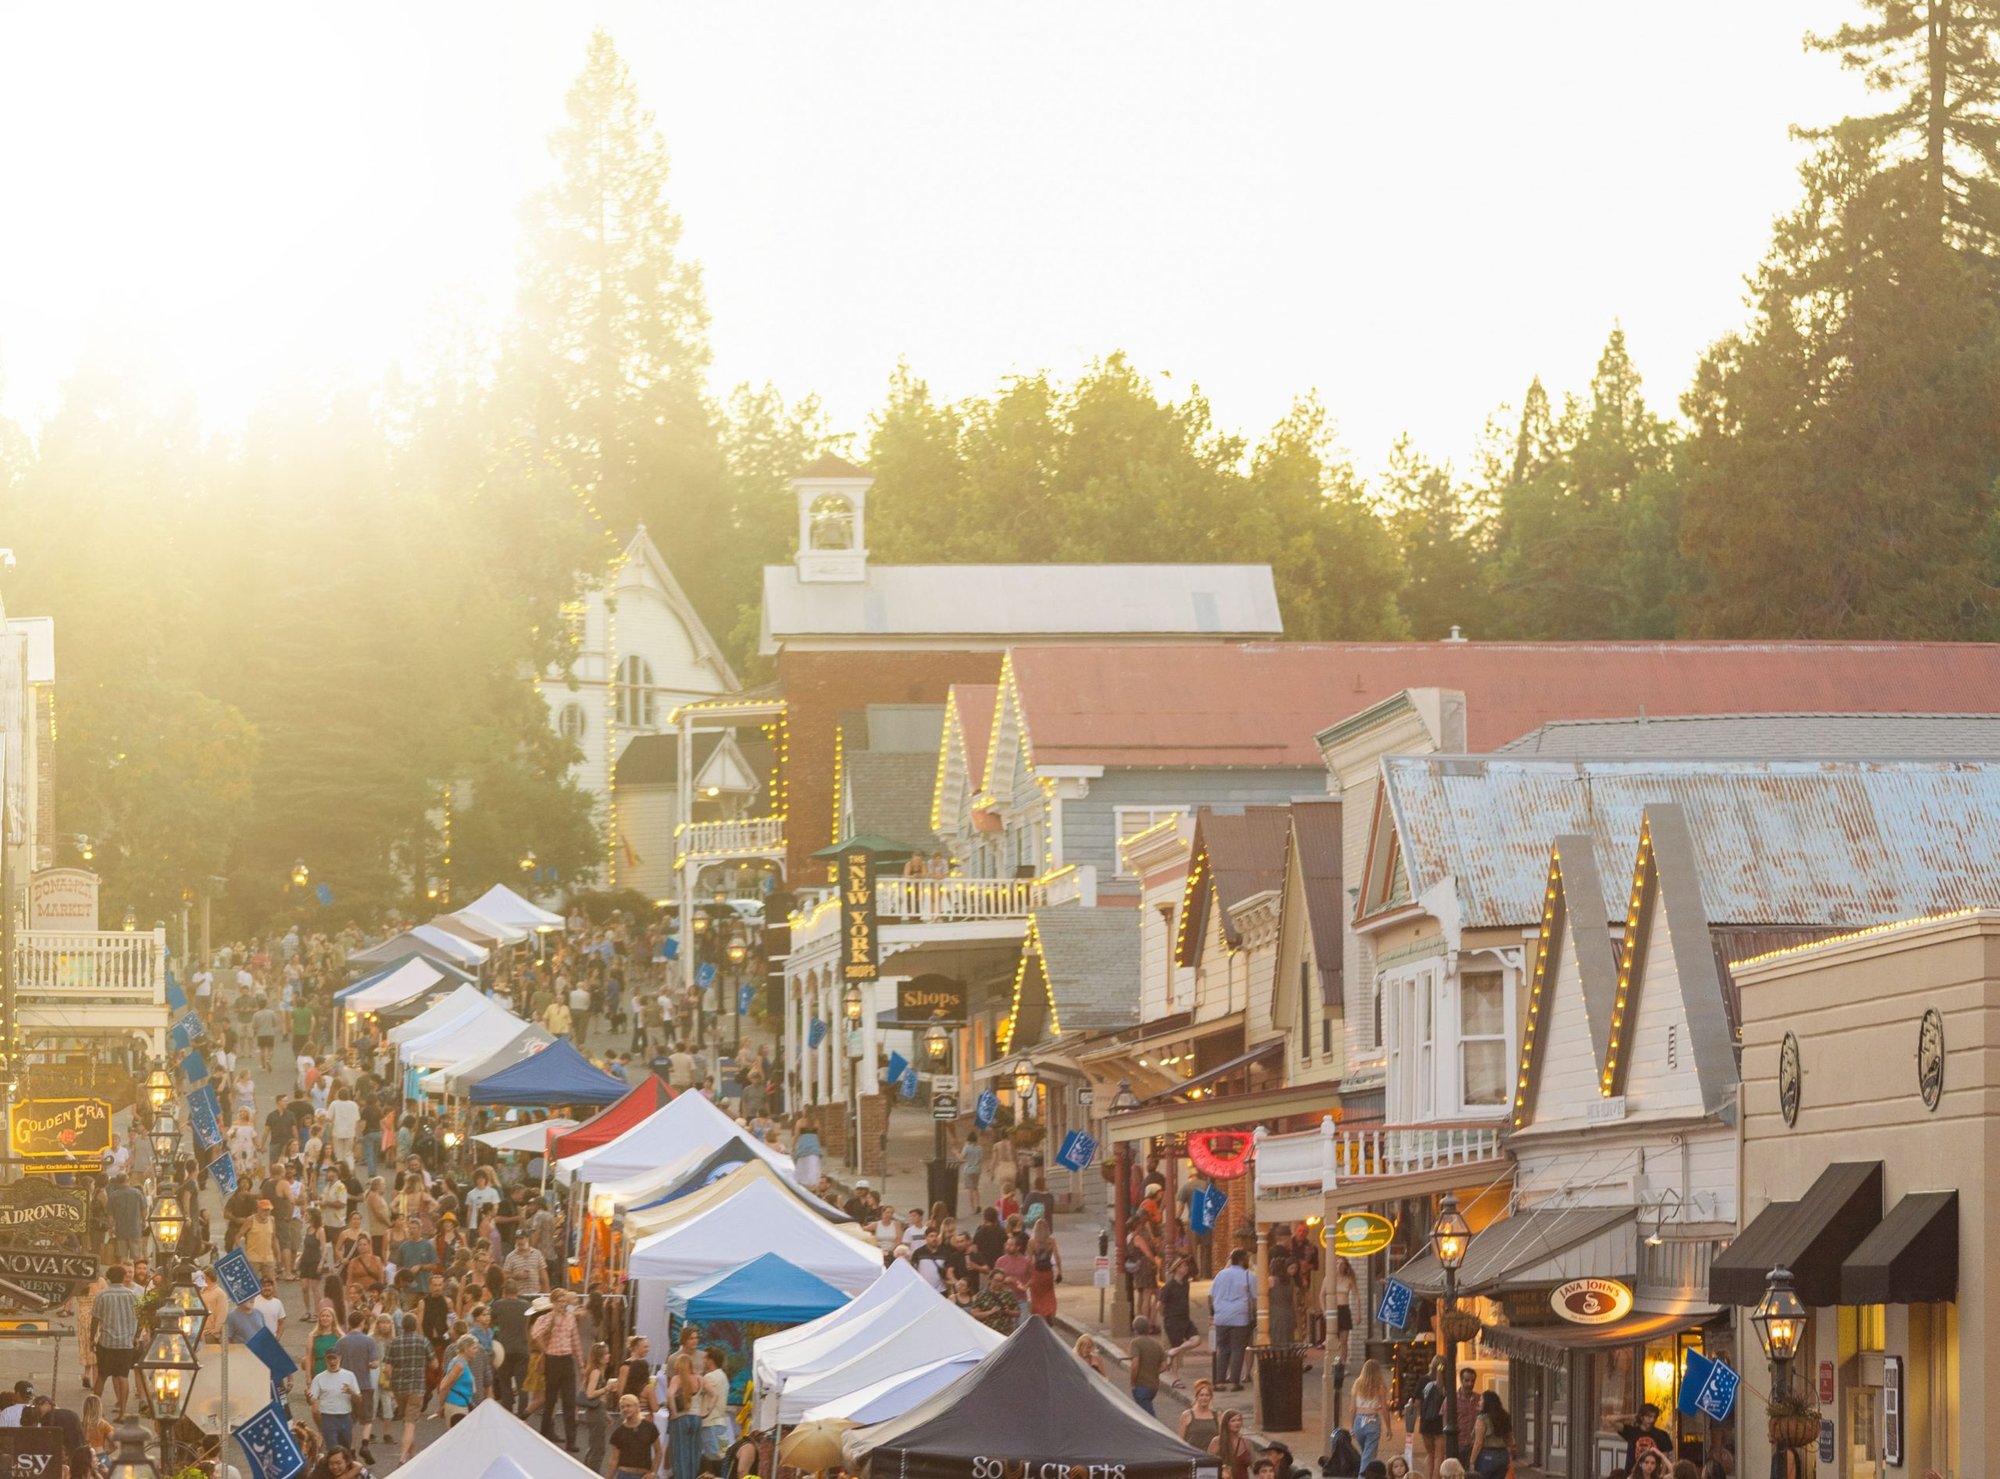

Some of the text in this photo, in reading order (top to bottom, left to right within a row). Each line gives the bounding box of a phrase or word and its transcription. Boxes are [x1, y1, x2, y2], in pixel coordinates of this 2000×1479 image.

[848, 855, 866, 863] THE
[37, 904, 92, 917] MARKET
[847, 865, 871, 962] NEW YORK
[904, 990, 960, 1008] Shops
[16, 1104, 106, 1144] GOLDEN ERA
[19, 1280, 66, 1292] MEN'S
[1560, 1280, 1621, 1300] JAVA JOHN'S
[12, 1453, 53, 1475] sy
